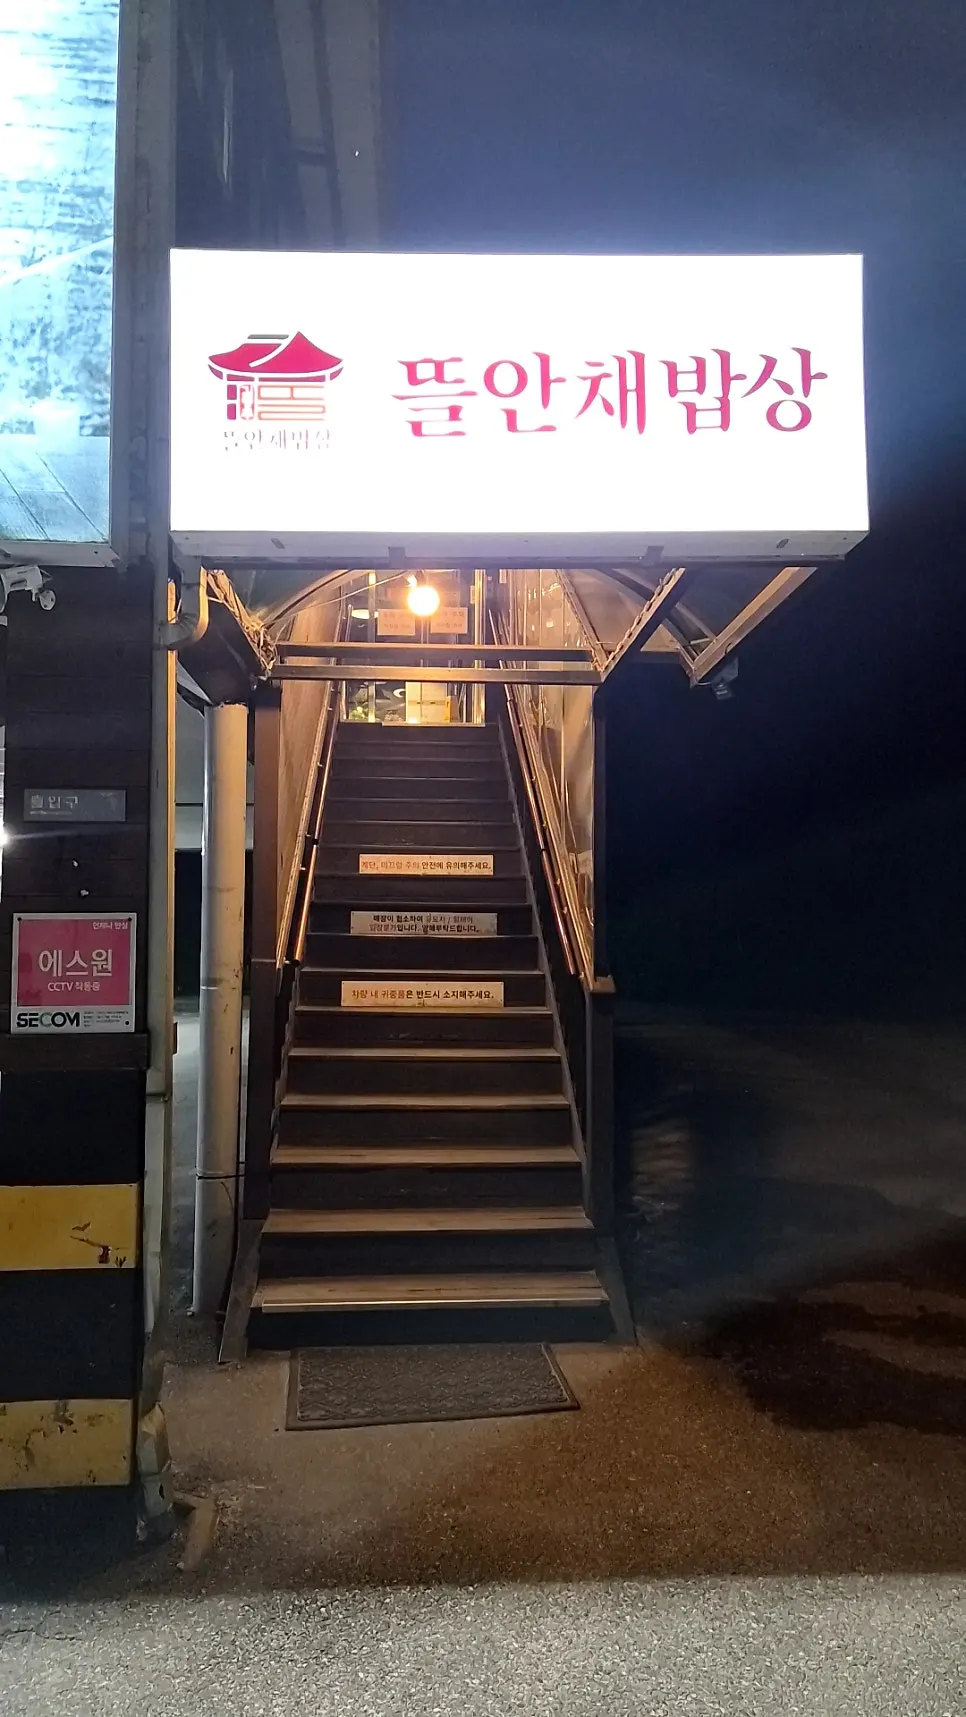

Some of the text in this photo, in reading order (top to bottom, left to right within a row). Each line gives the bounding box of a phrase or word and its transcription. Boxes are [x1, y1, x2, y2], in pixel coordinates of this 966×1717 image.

[391, 347, 829, 437] 뜰안채밥상
[381, 861, 403, 870] 미끄럼
[406, 861, 420, 870] 주의
[421, 861, 444, 870] 안전에
[446, 861, 492, 871] 유의해주세요.
[373, 915, 394, 923] 매장이
[396, 915, 423, 923] 협소하여
[38, 948, 113, 977] 에스원
[47, 981, 101, 992] CCTV 작동중
[351, 989, 495, 1000] 차량 내 귀중품은 반드시 소지해주세요.
[16, 1011, 81, 1028] SECOM
